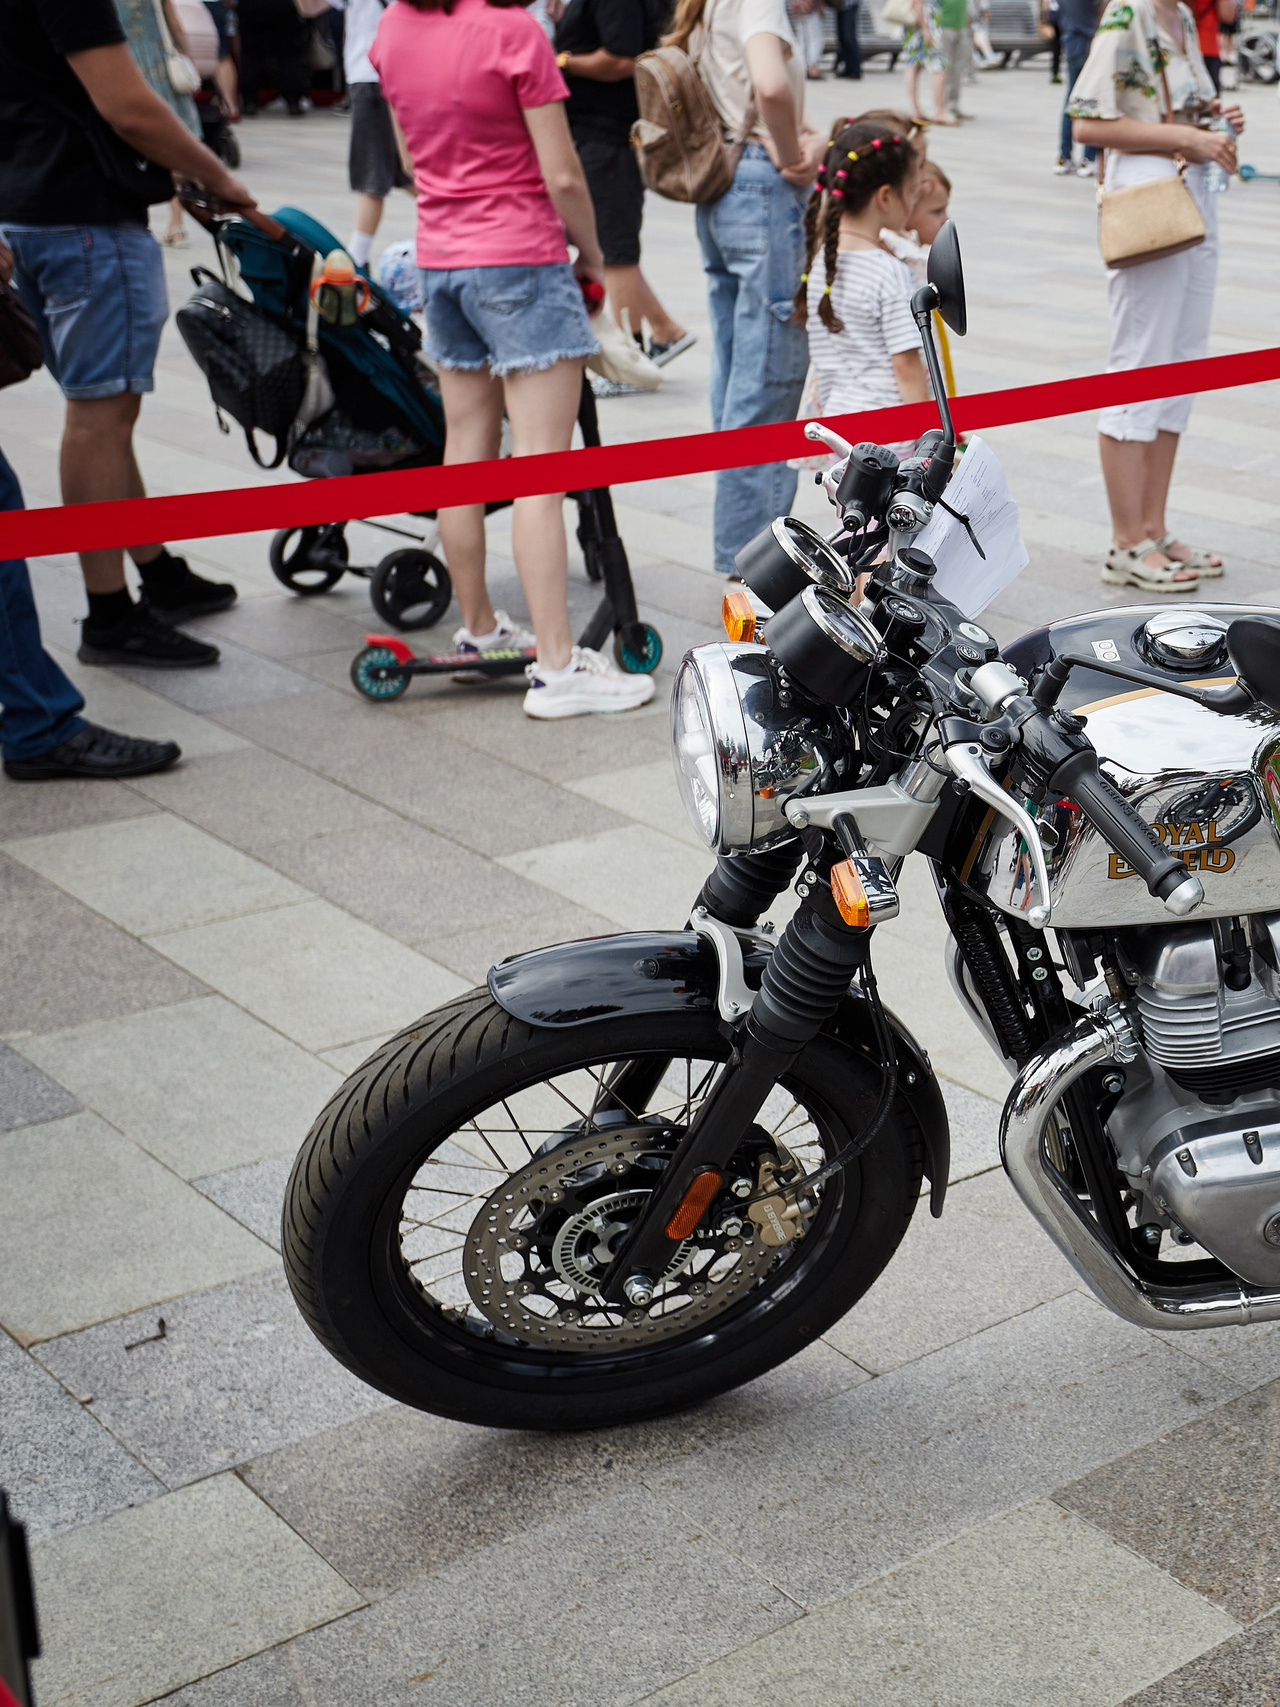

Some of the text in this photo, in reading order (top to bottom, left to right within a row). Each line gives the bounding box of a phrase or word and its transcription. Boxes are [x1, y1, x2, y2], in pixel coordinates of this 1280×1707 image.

[1099, 780, 1161, 849] ROYAL ENFIELD
[1148, 821, 1223, 845] OYAL
[1107, 848, 1236, 879] EELD
[767, 1213, 787, 1241] BYBRE
